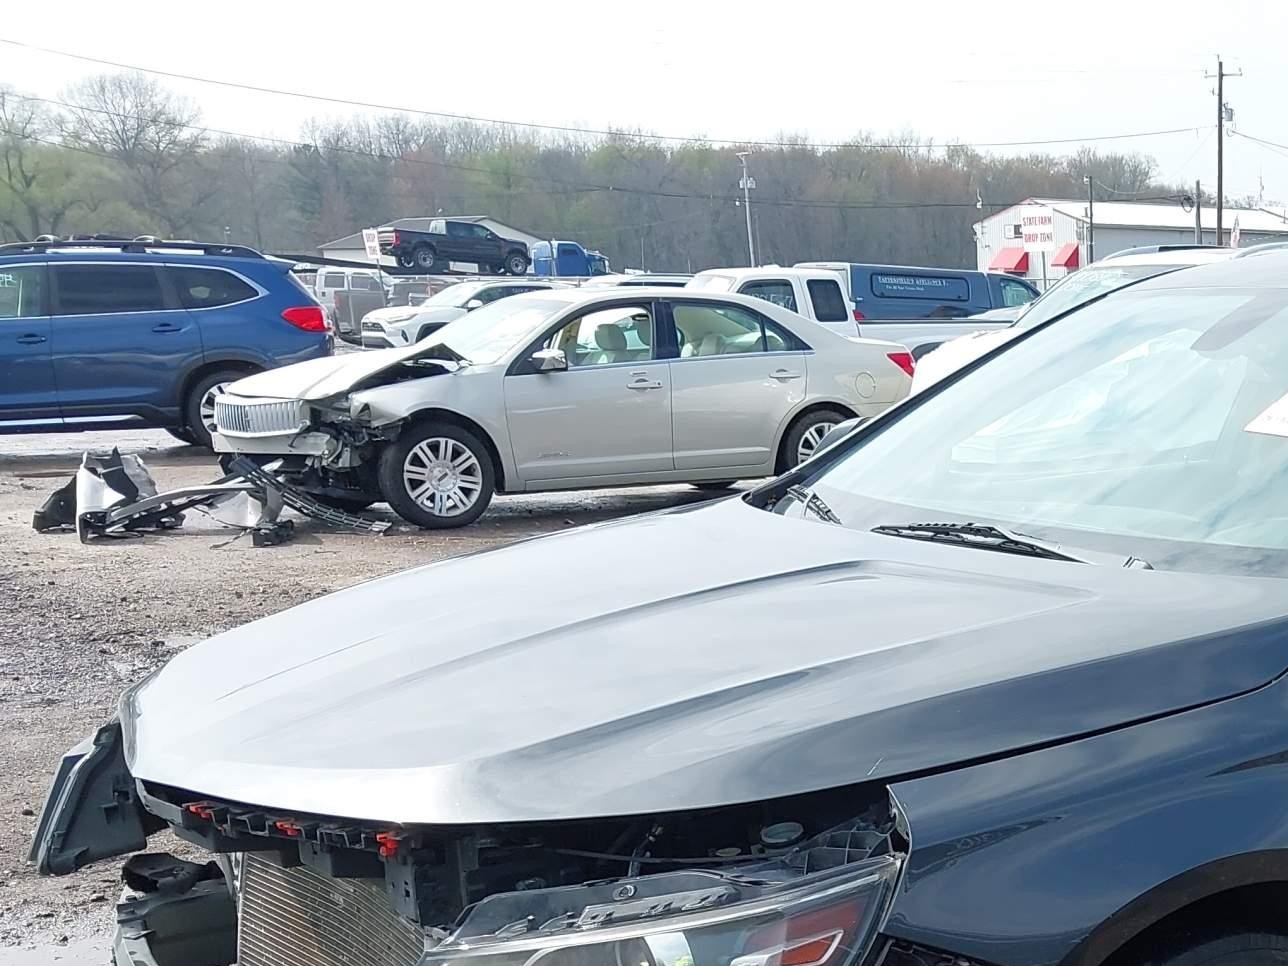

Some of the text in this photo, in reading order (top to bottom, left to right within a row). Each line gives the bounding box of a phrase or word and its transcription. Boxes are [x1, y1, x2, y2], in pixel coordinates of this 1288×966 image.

[1023, 216, 1052, 226] STATE FARM
[1024, 232, 1053, 242] DROP ZONE
